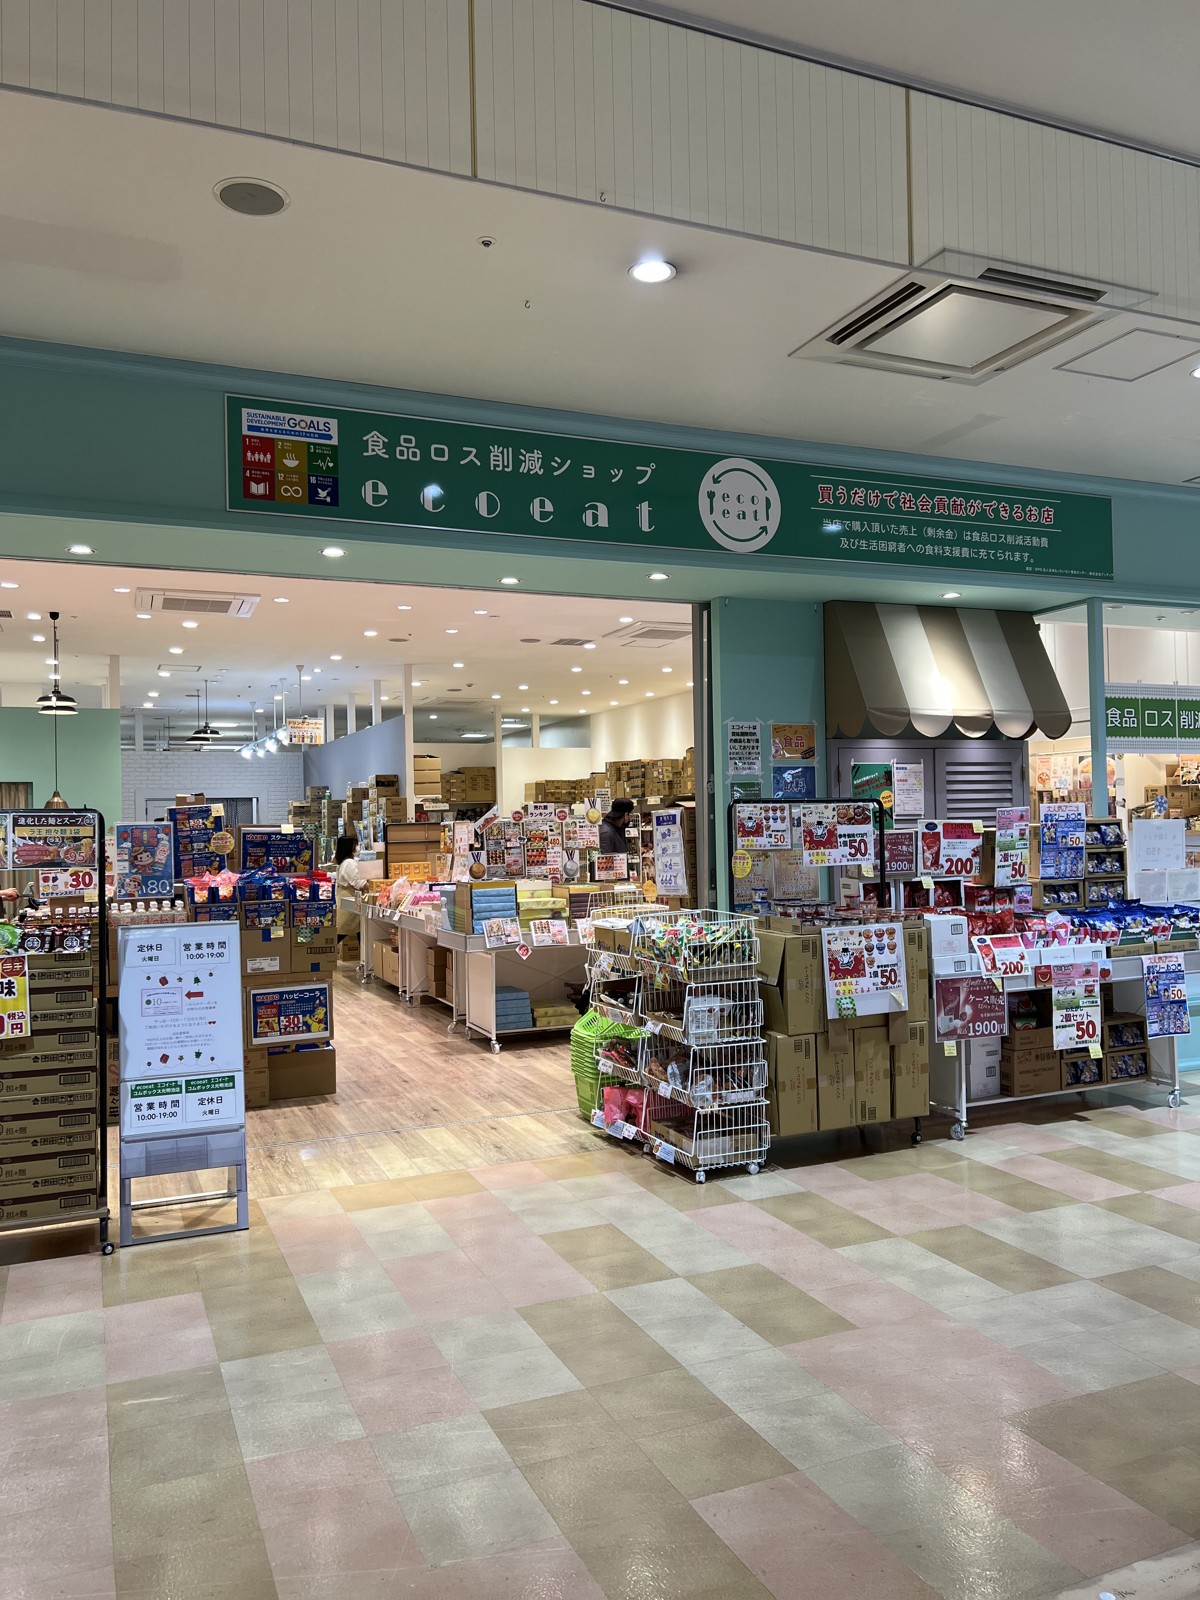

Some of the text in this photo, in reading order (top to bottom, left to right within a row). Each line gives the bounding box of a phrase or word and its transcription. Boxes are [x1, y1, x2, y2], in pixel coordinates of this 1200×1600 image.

[246, 412, 286, 422] SUSTAINABLE
[246, 417, 331, 432] DEVELOPMENT GOALS
[362, 429, 658, 486] 食品ロス削減ショップ
[720, 490, 760, 506] eco
[360, 478, 656, 533] ecoeat
[818, 484, 1055, 524] 買うだけで社会貢献ができるお店
[721, 506, 760, 522] eat
[783, 735, 804, 748] 食品
[17, 817, 84, 825] 進化した麺とスープ
[774, 834, 785, 844] 50
[1069, 837, 1081, 846] 50
[848, 839, 868, 857] 50
[885, 862, 914, 871] 1900円
[1011, 862, 1025, 878] 50
[69, 871, 94, 888] 30
[137, 941, 226, 952] 定休日 営業時間
[186, 952, 225, 960] 10:00-19:00
[869, 968, 897, 986] 1個 50
[283, 991, 320, 999] ハッピーコーラ
[968, 994, 1005, 1005] ケース販売
[1171, 989, 1183, 1000] 50
[7, 1011, 26, 1020] 税込
[1060, 1012, 1091, 1022] 2個セット
[11, 1023, 23, 1034] 円
[968, 1020, 1006, 1036] 1900円
[1076, 1020, 1096, 1040] 50
[134, 1100, 180, 1112] 営業時間
[198, 1096, 223, 1106] 定休日
[137, 1111, 178, 1121] 10:00-19:00
